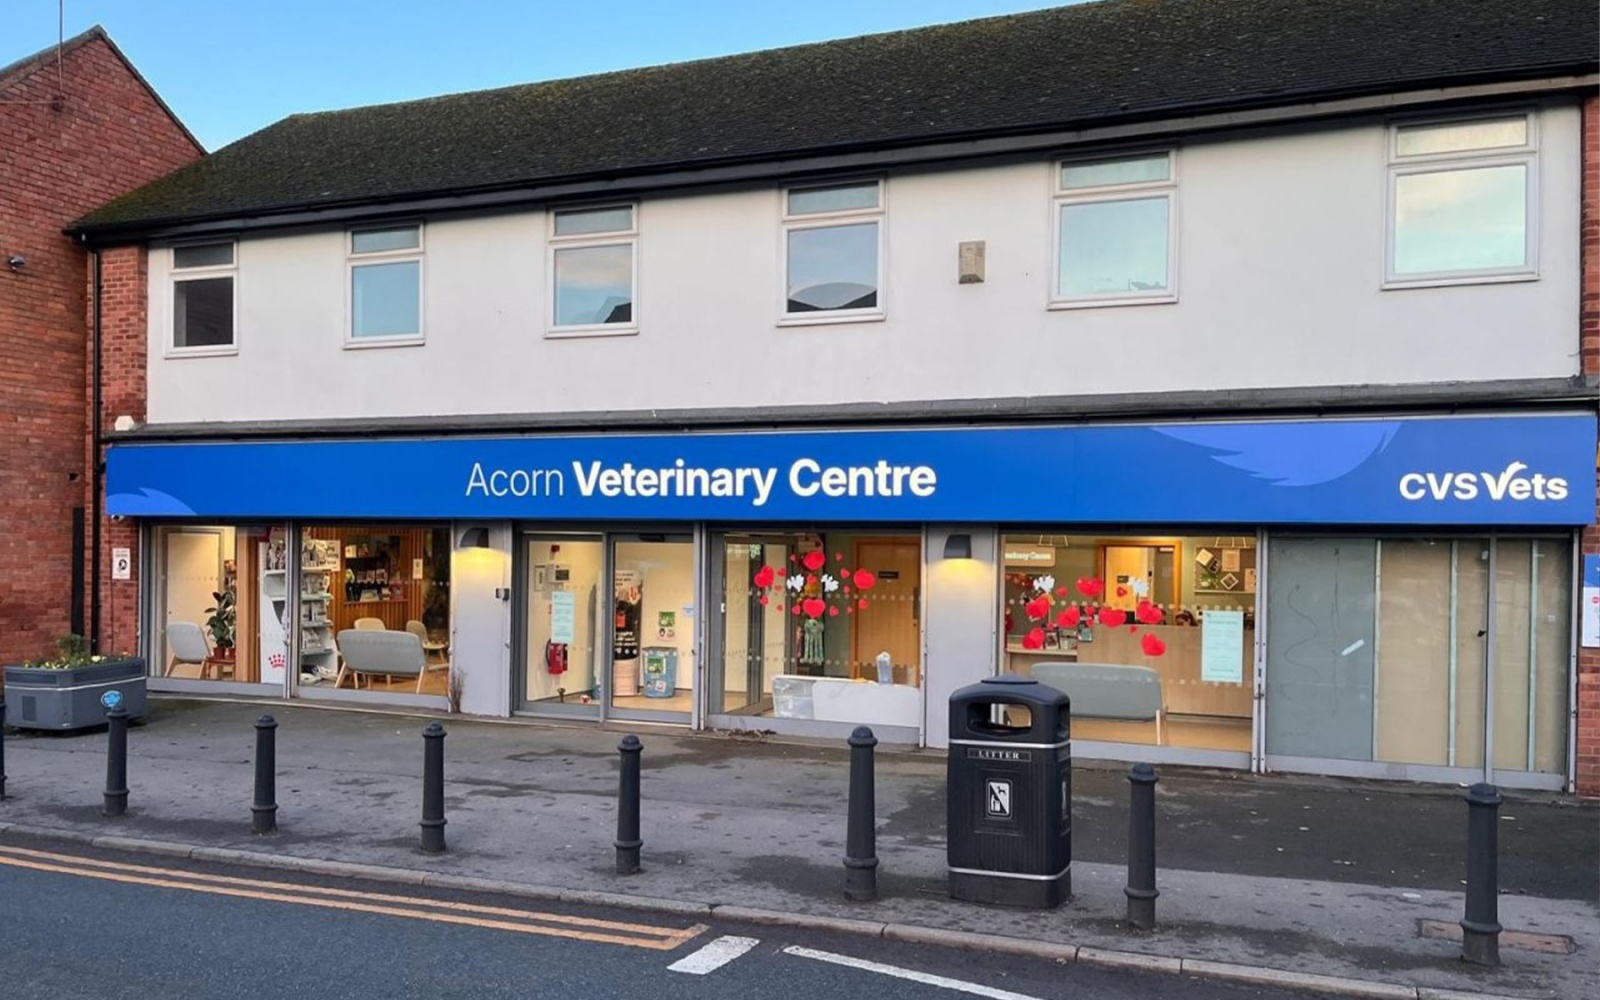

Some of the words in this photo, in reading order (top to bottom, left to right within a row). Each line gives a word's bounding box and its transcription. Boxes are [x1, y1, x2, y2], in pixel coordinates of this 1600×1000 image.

[466, 462, 564, 497] Acorn
[572, 458, 778, 507] Veterinary
[788, 457, 937, 498] Centre
[978, 749, 1020, 759] LITTER
